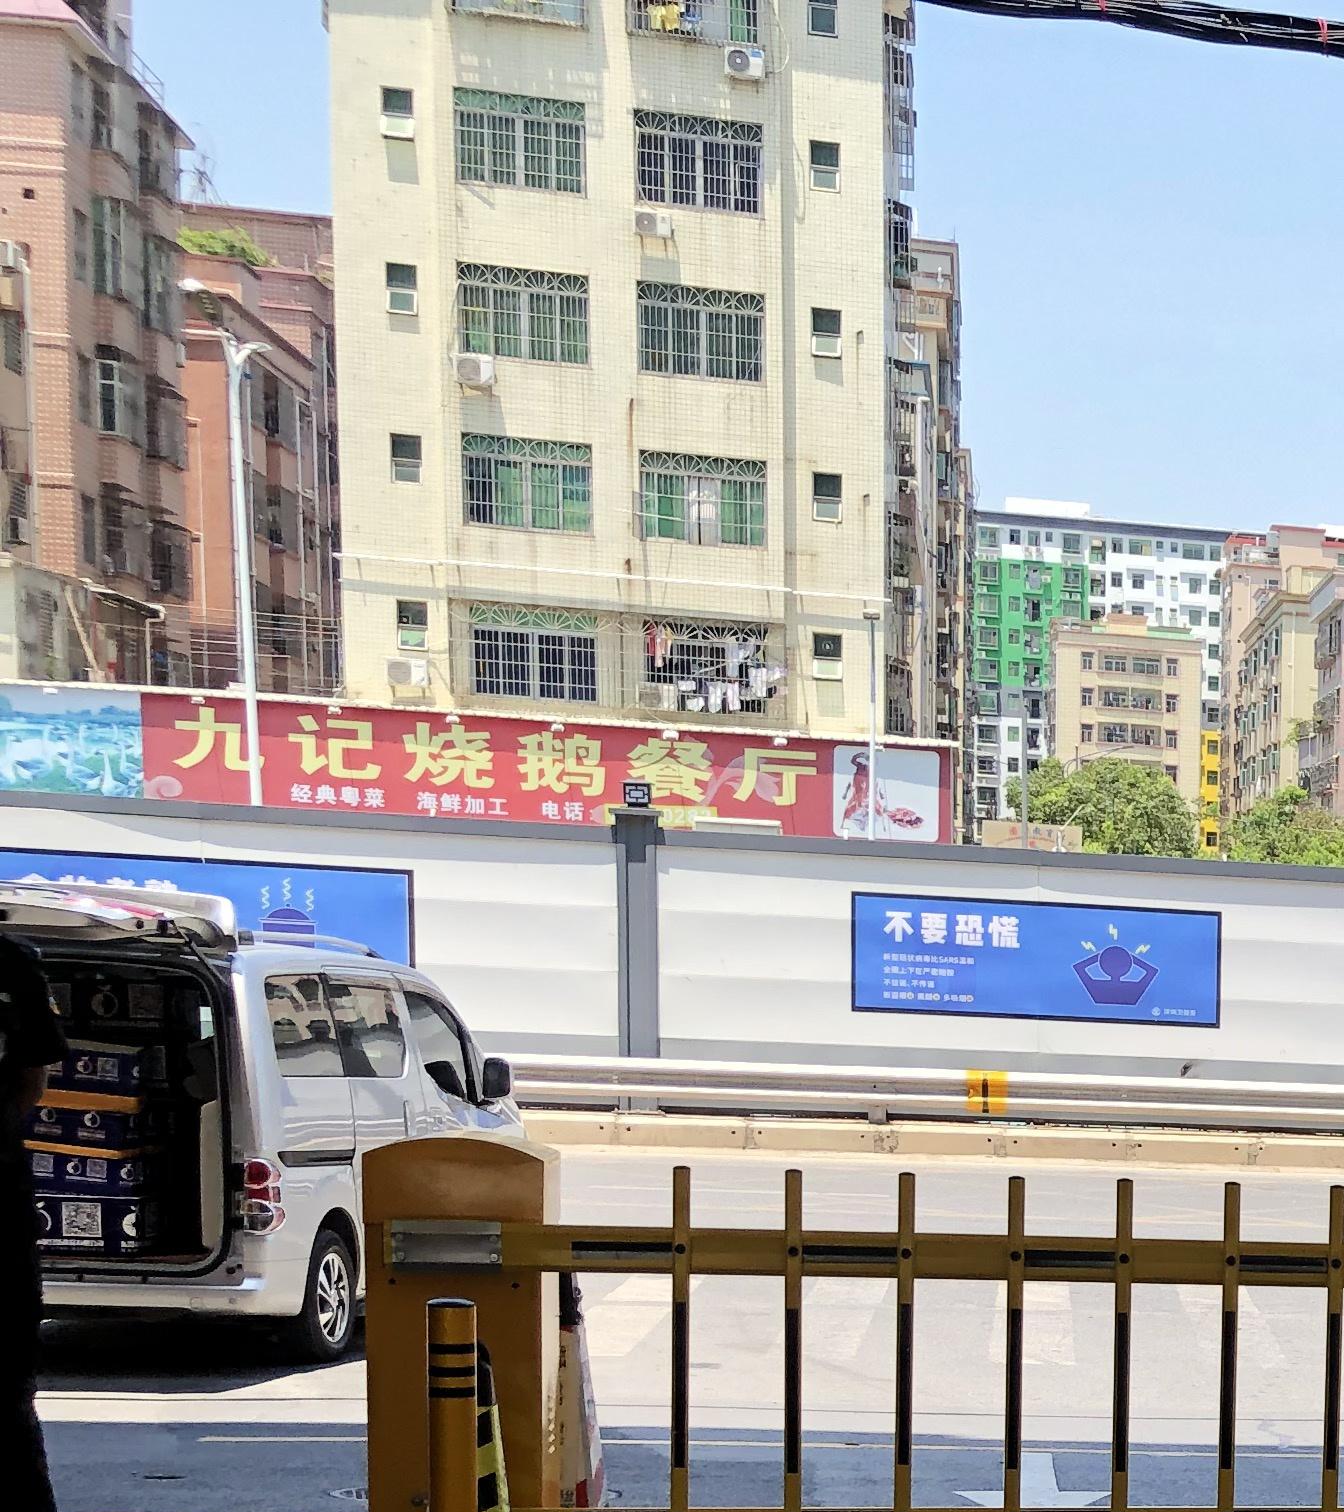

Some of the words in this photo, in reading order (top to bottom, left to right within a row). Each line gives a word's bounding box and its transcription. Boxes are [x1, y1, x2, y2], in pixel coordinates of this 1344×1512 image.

[173, 704, 818, 807] 九记烧鹅餐厅
[290, 783, 386, 809] 经典粤菜
[416, 790, 510, 817] 海鲜加工
[882, 909, 1022, 949] 不要恐慌
